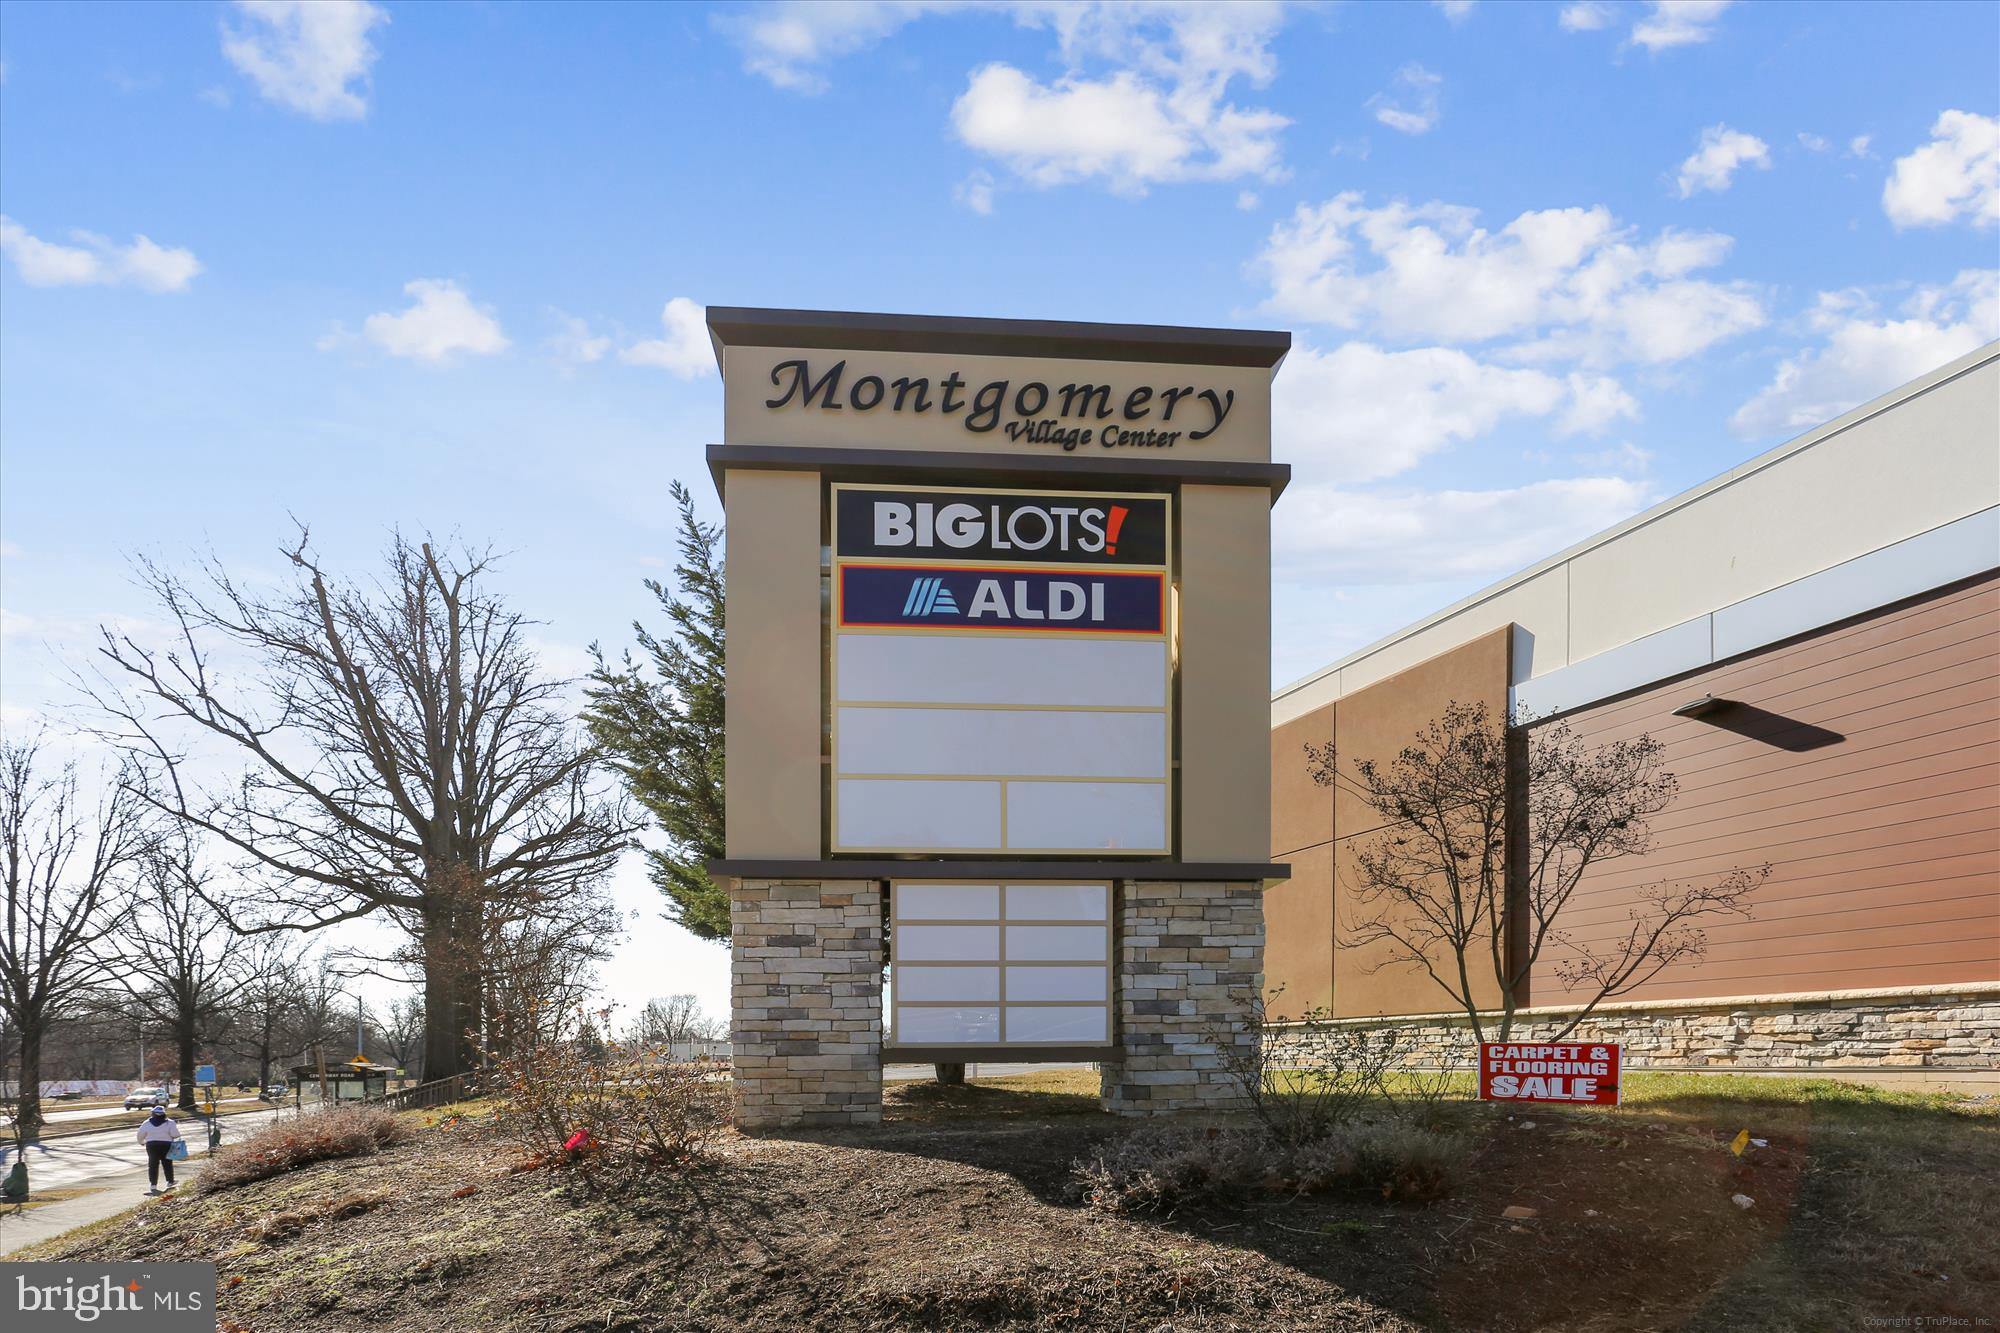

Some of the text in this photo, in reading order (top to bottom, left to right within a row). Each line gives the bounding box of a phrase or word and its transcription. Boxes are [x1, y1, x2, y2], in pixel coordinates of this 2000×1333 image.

[765, 359, 1235, 440] Montgomery
[1005, 420, 1182, 451] Village Center
[967, 579, 1105, 621] ALDI
[1488, 1046, 1610, 1060] CARPET &
[1490, 1061, 1608, 1075] FLOORING
[1490, 1075, 1598, 1100] SALE
